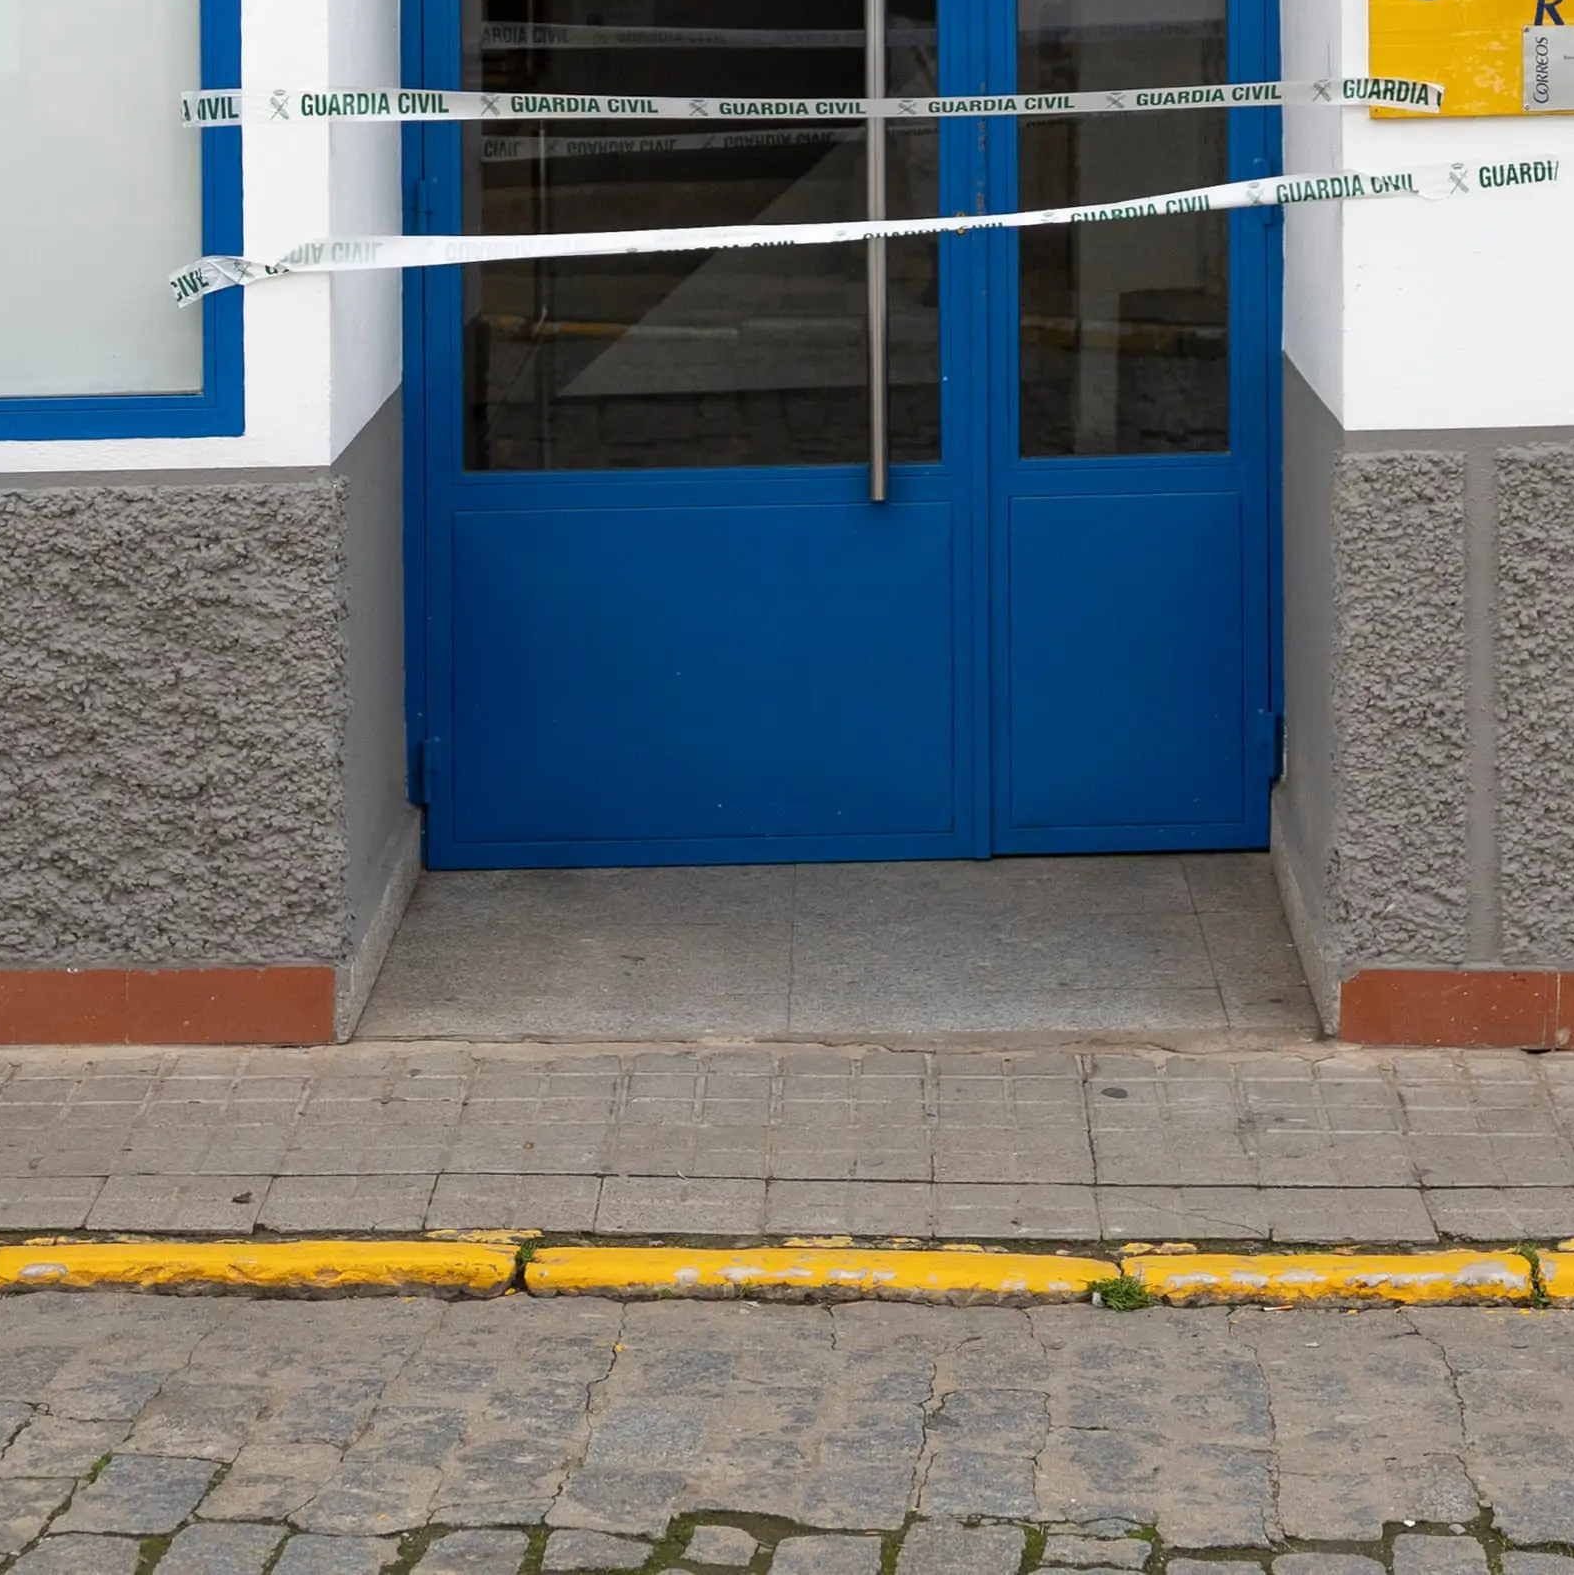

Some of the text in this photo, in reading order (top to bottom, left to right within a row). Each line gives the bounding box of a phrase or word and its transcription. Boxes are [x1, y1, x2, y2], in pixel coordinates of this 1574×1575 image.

[300, 92, 391, 117] GUARDIA
[397, 92, 450, 115] CIVIL
[510, 95, 600, 115] GUARDIA
[607, 97, 659, 115] CIVIL
[718, 101, 809, 116] GUARDIA
[815, 101, 867, 115] CIVIL
[928, 97, 1017, 114] GUARDIA
[1024, 95, 1075, 111] CIVIL
[1136, 88, 1225, 107] GUARDIA
[1231, 84, 1282, 102] CIVIL
[1343, 78, 1429, 106] GUARDIA
[1276, 174, 1366, 204] GUARDIA
[1370, 173, 1420, 195] CIVIL
[1479, 159, 1560, 189] GUARDI
